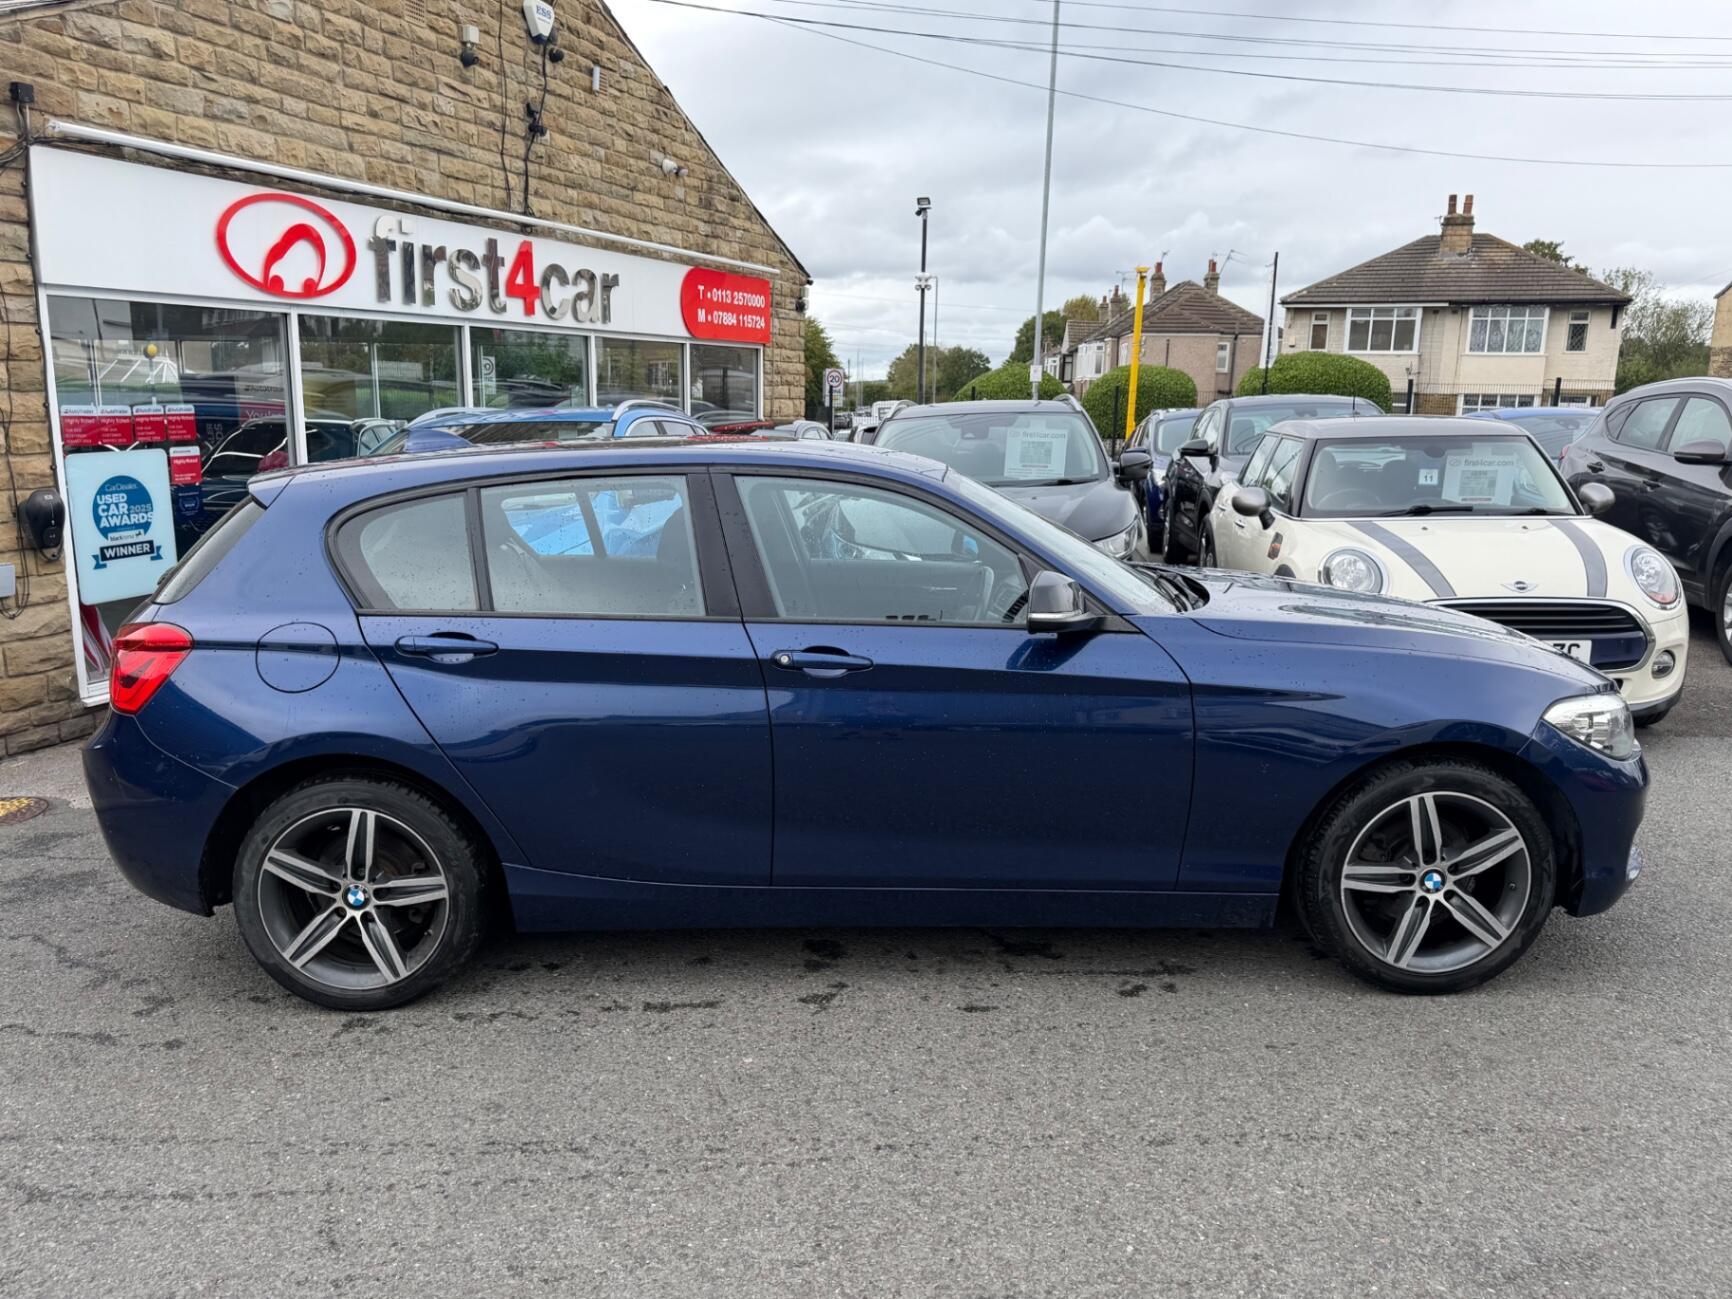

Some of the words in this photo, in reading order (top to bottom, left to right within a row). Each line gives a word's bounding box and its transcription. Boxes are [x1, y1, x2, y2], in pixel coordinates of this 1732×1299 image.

[368, 215, 620, 325] first4car
[697, 285, 705, 300] T
[711, 288, 732, 304] 0113
[733, 291, 766, 308] 2570000
[697, 308, 706, 323] M
[739, 314, 766, 329] 115724
[829, 374, 840, 383] 20
[96, 493, 128, 504] USED
[98, 502, 128, 516] CAR
[129, 504, 152, 513] 2025
[100, 511, 154, 528] AWARDS
[104, 542, 151, 558] WINNER
